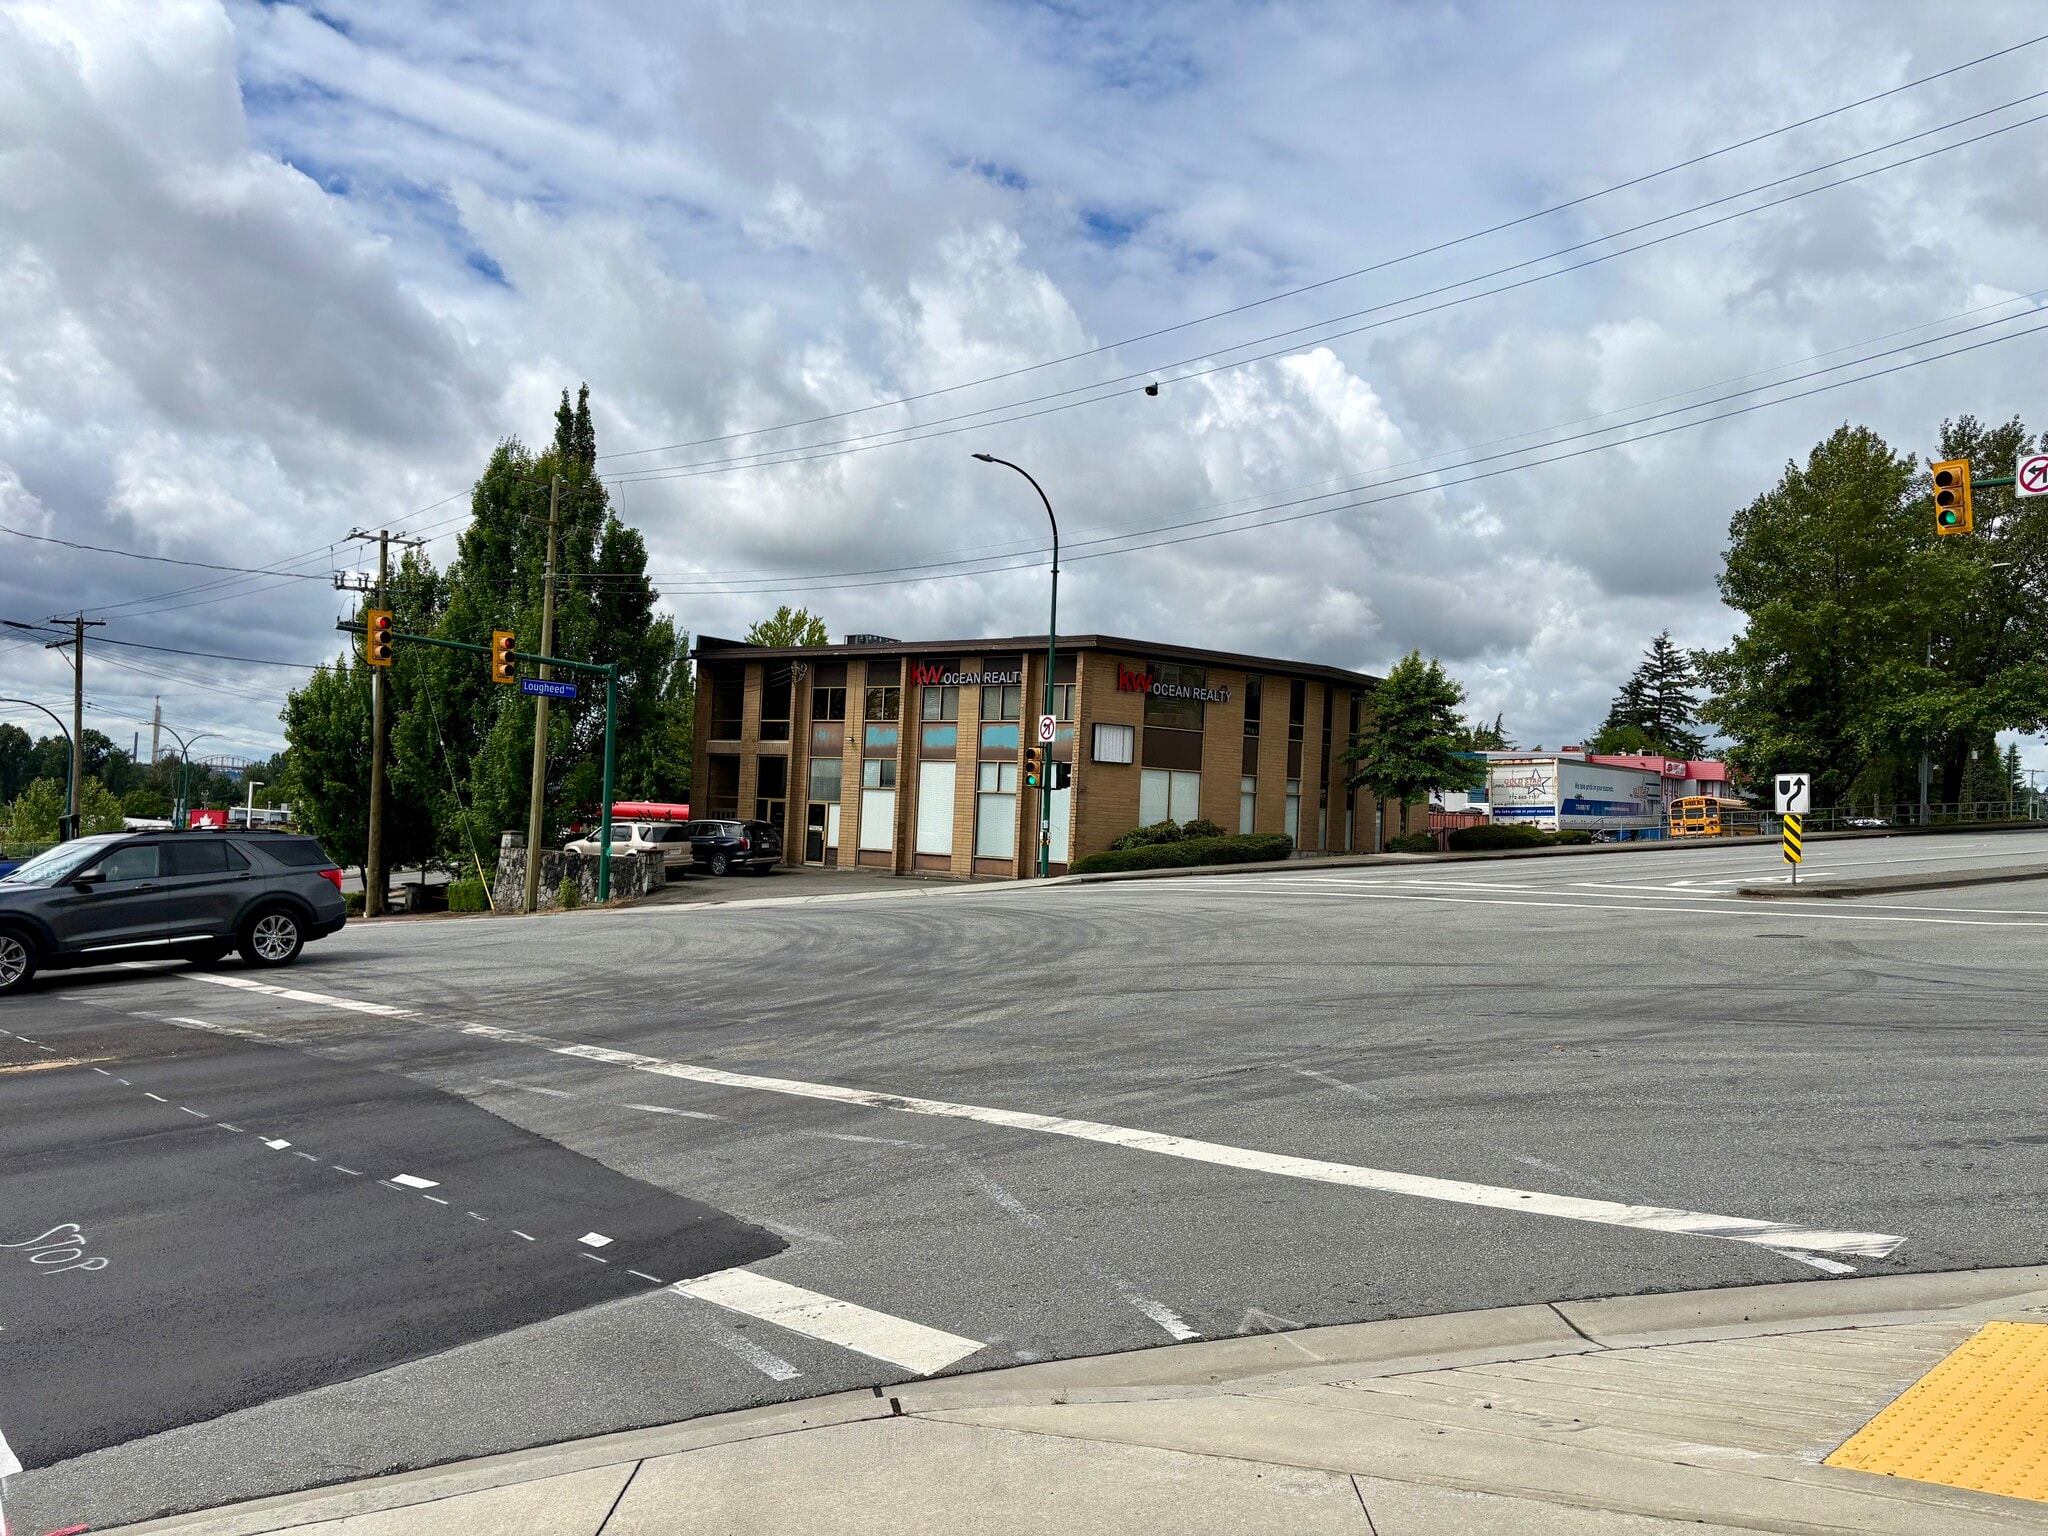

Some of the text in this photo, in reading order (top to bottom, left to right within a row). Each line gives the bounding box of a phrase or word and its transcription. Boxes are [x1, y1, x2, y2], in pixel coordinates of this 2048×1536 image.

[943, 672, 981, 684] OCEAN
[524, 681, 565, 694] Lougheed
[1152, 682, 1190, 698] OCEAN
[1192, 687, 1232, 702] REALTY
[0, 1223, 109, 1275] STOP
